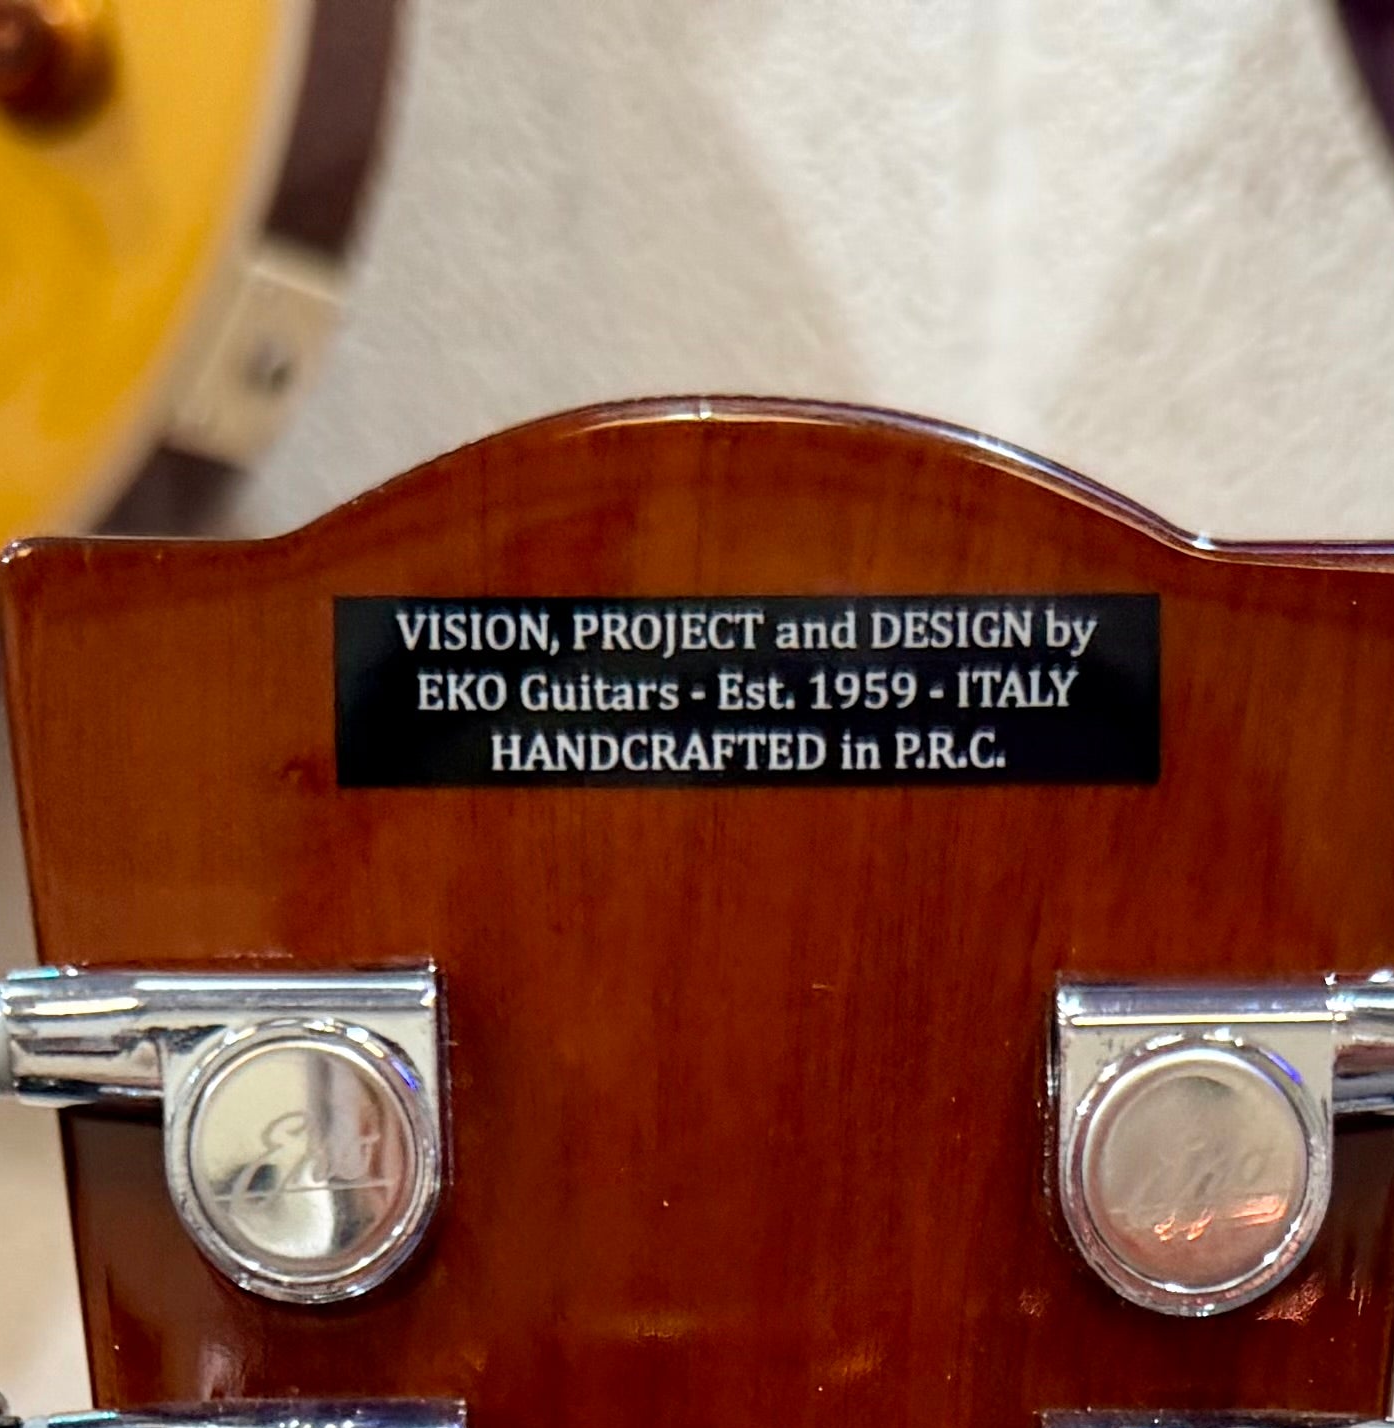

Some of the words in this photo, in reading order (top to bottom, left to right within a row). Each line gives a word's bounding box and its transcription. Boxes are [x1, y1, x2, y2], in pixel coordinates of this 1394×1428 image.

[395, 611, 561, 656] VISION,
[572, 611, 766, 659] PROJECT
[775, 611, 857, 650] and
[870, 610, 1033, 650] DESIGN
[1044, 608, 1098, 657] by
[416, 672, 508, 712] EKO
[519, 672, 681, 712] Guitars
[717, 671, 796, 711] Est.
[808, 670, 918, 711] 1959
[956, 670, 1080, 709] ITALY
[490, 731, 828, 773] HANDCRAFTED
[840, 731, 882, 771] in
[893, 730, 1007, 771] P.R.C.
